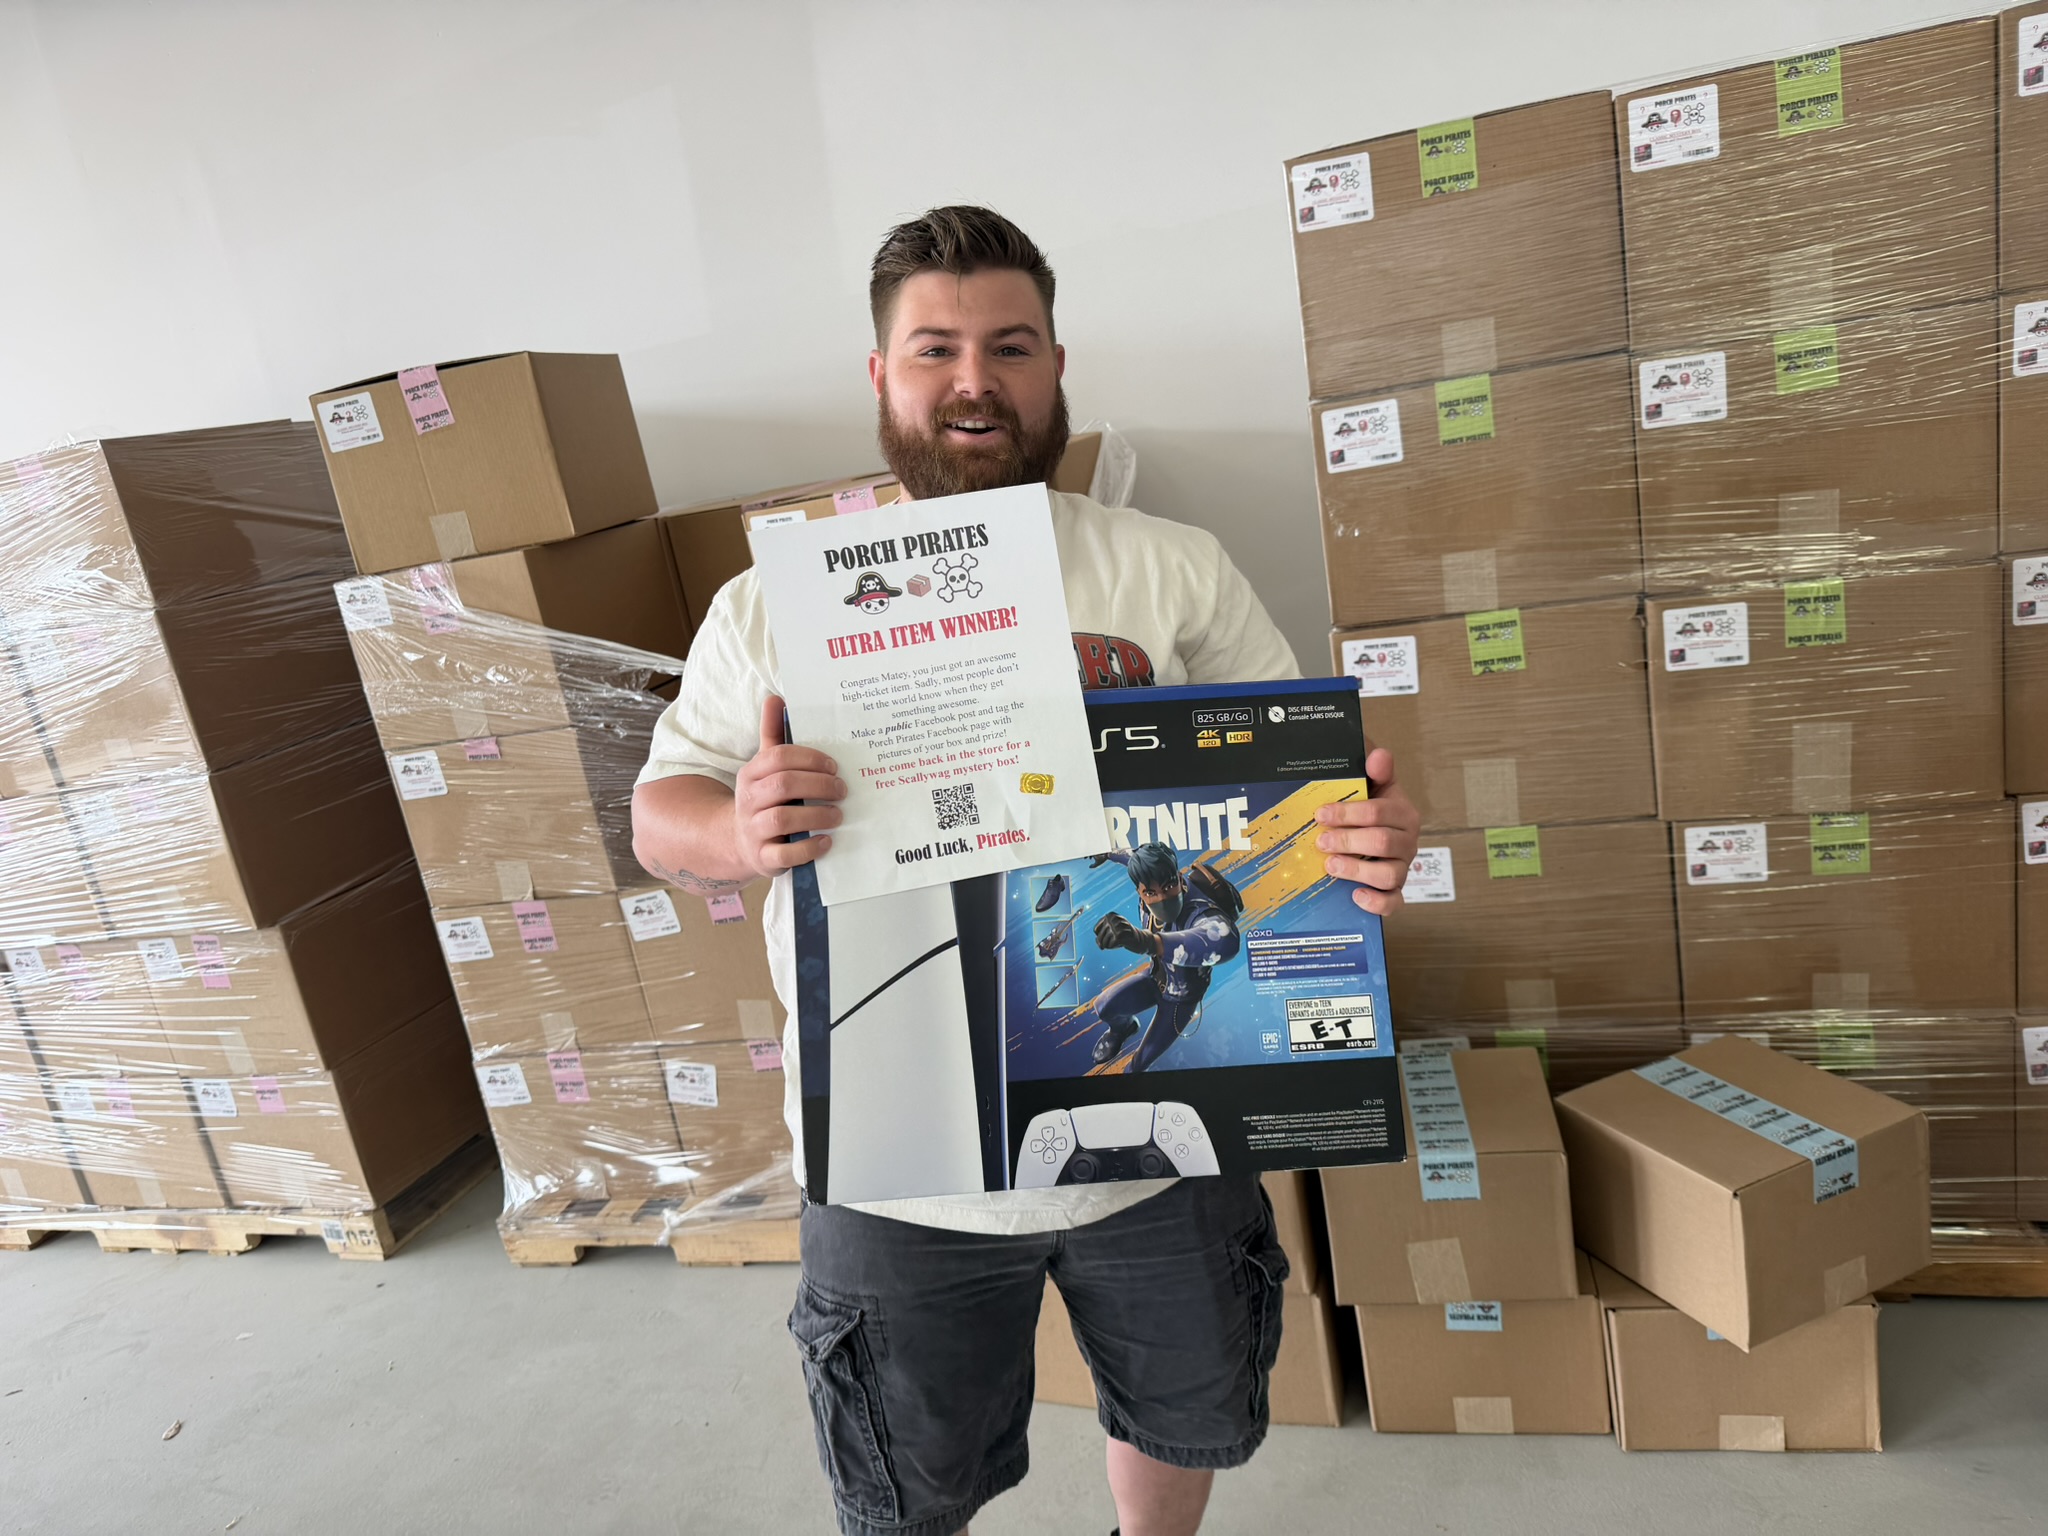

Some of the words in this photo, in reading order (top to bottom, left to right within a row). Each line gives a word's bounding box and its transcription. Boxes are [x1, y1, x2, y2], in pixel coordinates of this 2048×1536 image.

[1655, 99, 1673, 108] PORCH
[1675, 94, 1696, 103] PIRATES
[1780, 100, 1806, 112] PORCH
[1808, 92, 1838, 106] PIRATES
[1420, 134, 1442, 148] PORCH
[1444, 130, 1472, 143] PIRATES
[1423, 176, 1445, 188] PORCH
[1448, 170, 1475, 184] PIRATES
[404, 386, 420, 395] PORCH
[421, 380, 439, 390] PIRATES
[1439, 400, 1461, 409] PORCH
[1462, 395, 1488, 405] PIRATES
[415, 416, 430, 424] PORCH
[431, 409, 449, 419] PIRATES
[824, 539, 899, 573] PORCH
[902, 523, 989, 559] PIRATES
[1788, 597, 1811, 606] PORCH
[1813, 594, 1841, 603] PIRATES
[827, 631, 886, 659] ULTRA
[889, 621, 936, 648] ITEM
[939, 606, 1019, 638] WINNER!
[1470, 624, 1491, 633] PORCH
[1492, 620, 1518, 630] PIRATES
[840, 676, 879, 689] Congrats
[881, 671, 910, 682] Matey,
[913, 667, 929, 678] you
[930, 663, 947, 675] just
[948, 661, 963, 672] got
[977, 651, 1017, 664] awesome
[1071, 632, 1155, 691] ER
[1474, 658, 1495, 668] PORCH
[1496, 655, 1522, 664] PIRATES
[842, 686, 889, 702] high-ticket
[891, 683, 913, 692] item.
[914, 677, 942, 689] Sadly,
[943, 674, 964, 684] most
[966, 668, 995, 681] people
[863, 703, 874, 711] let
[876, 700, 889, 709] the
[891, 694, 917, 706] world
[919, 692, 942, 701] know
[944, 687, 968, 696] when
[969, 682, 988, 694] they
[990, 680, 1004, 690] get
[892, 705, 936, 719] something
[937, 697, 980, 710] awesome.
[1197, 713, 1214, 723] 825
[1217, 712, 1248, 722] GB/Go
[851, 728, 876, 739] Make
[885, 721, 912, 735] public
[914, 713, 956, 728] Facebook
[958, 710, 976, 722] post
[978, 706, 994, 717] and
[996, 704, 1009, 715] tag
[1010, 700, 1024, 710] the
[868, 737, 894, 749] Porch
[896, 732, 925, 744] Pirates
[927, 723, 968, 738] Facebook
[970, 721, 991, 732] page
[992, 715, 1012, 725] with
[1196, 729, 1221, 738] 4K
[1229, 733, 1251, 741] HDR
[877, 747, 912, 762] pictures
[913, 744, 923, 753] of
[925, 741, 945, 753] your
[946, 737, 963, 747] box
[965, 734, 981, 744] and
[983, 729, 1007, 742] prize!
[859, 766, 887, 778] Then
[889, 762, 916, 773] come
[918, 755, 944, 767] back
[946, 753, 957, 762] in
[959, 748, 976, 759] the
[978, 745, 1004, 756] store
[1006, 742, 1022, 751] for
[875, 779, 896, 789] free
[898, 769, 951, 786] Scallywag
[953, 761, 994, 776] mystery
[996, 755, 1019, 767] box!
[895, 844, 932, 865] Good
[935, 838, 974, 858] Luck,
[976, 828, 1030, 849] Pirates.
[1289, 1001, 1312, 1009] EVERYONE
[1290, 1010, 1309, 1018] ENFANTS
[1339, 1007, 1370, 1015] ADOLESCENTS
[1263, 1033, 1278, 1044] EPIC
[1310, 1019, 1352, 1040] E-T
